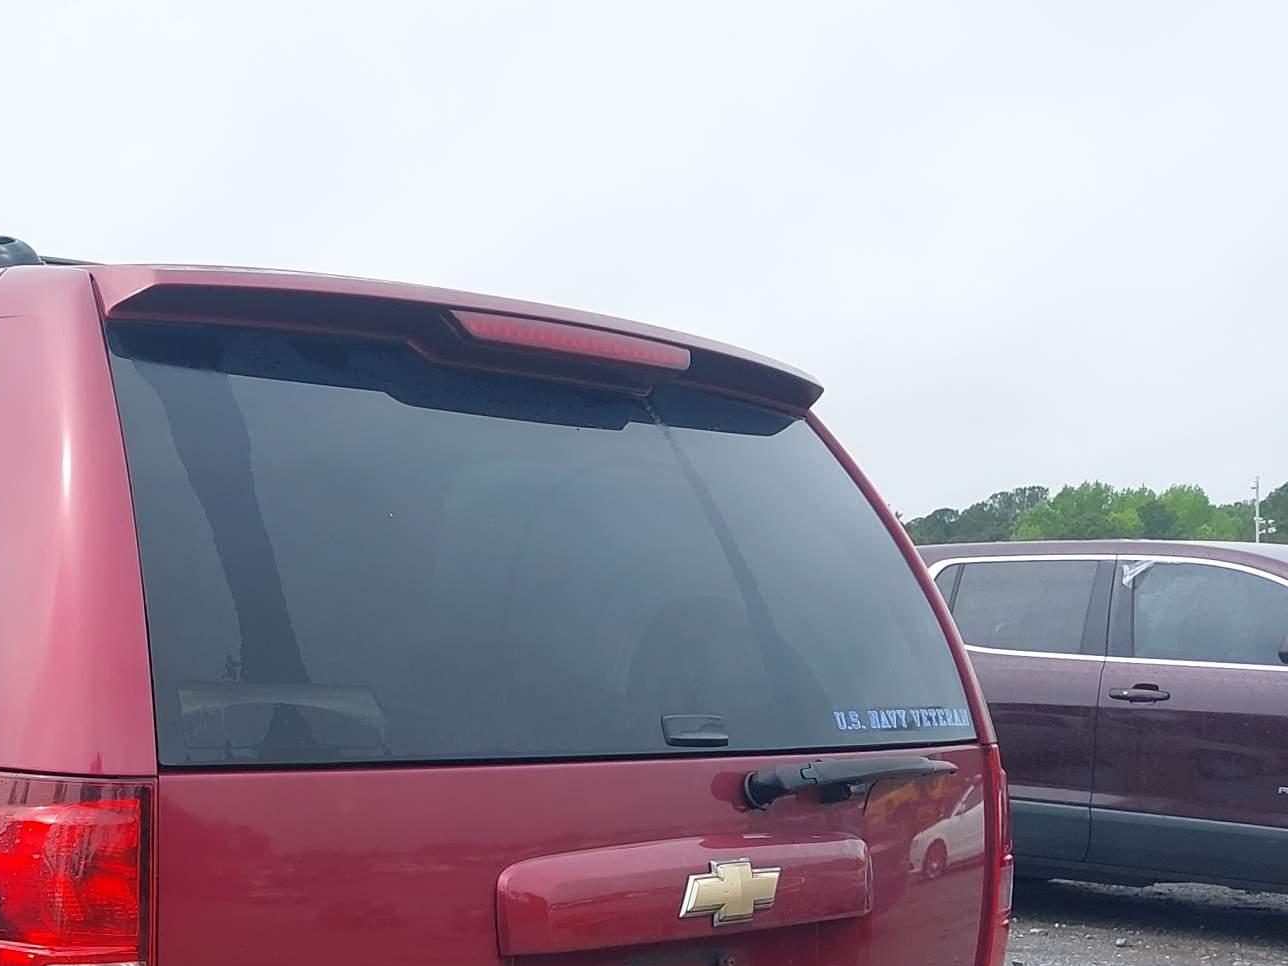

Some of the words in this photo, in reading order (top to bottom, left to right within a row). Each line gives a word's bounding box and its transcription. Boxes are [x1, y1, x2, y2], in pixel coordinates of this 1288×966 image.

[833, 711, 866, 730] U.S.
[867, 709, 907, 729] NAVY
[910, 708, 970, 728] VETERAN
